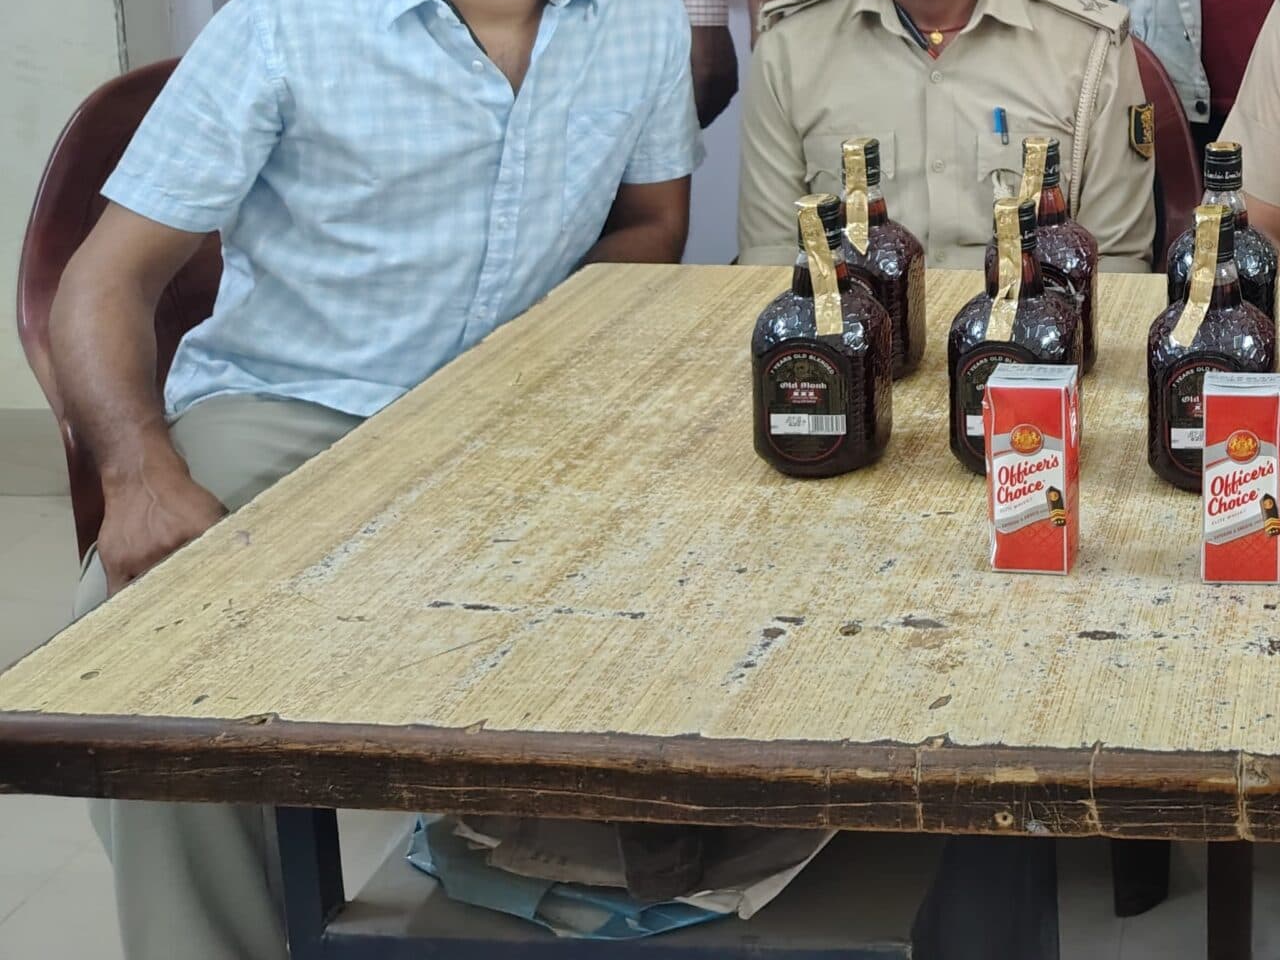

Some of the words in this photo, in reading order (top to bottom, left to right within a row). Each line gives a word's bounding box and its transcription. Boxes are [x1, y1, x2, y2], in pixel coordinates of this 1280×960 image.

[998, 454, 1059, 486] Officer's
[1210, 460, 1274, 497] Officer's
[997, 481, 1044, 504] Choice
[1208, 490, 1258, 516] Choice
